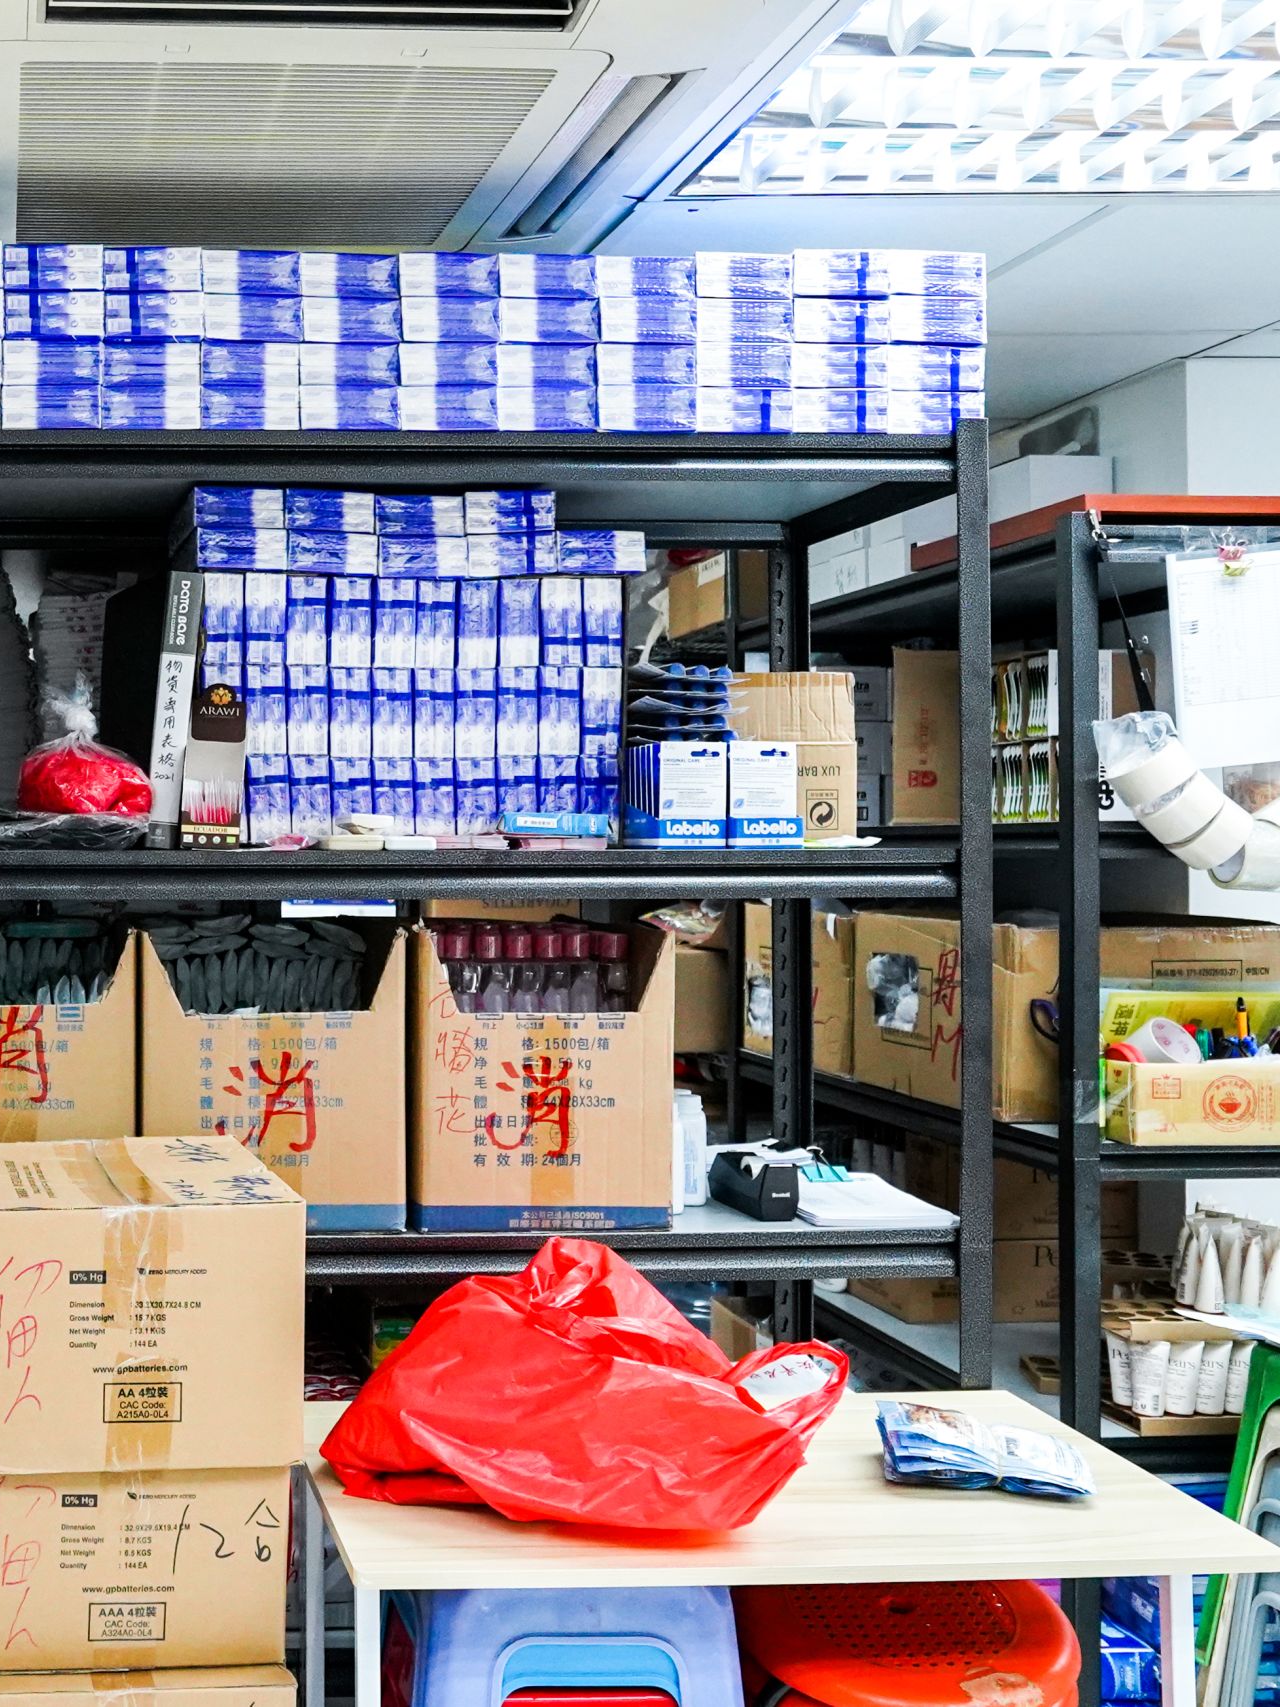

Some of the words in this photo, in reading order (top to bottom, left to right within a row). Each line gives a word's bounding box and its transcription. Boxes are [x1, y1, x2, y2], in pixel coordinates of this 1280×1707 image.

[199, 706, 240, 717] ARAWI
[154, 771, 175, 782] 2021
[797, 766, 818, 777] BAR
[822, 765, 841, 777] LUX
[193, 826, 228, 834] ECUADOR
[666, 820, 720, 836] Labello
[743, 819, 797, 835] Labello
[545, 1037, 610, 1051] 1500包/箱
[72, 1272, 88, 1281] 0%
[89, 1272, 104, 1283] Hg
[69, 1301, 105, 1309] Dimension
[189, 1300, 202, 1308] CM
[69, 1314, 90, 1322] Gross
[91, 1314, 115, 1323] Weight
[150, 1314, 167, 1322] KGS
[82, 1327, 106, 1336] Weight
[69, 1341, 97, 1350] Quantity
[134, 1340, 146, 1348] 144
[147, 1339, 158, 1348] EA
[92, 1363, 188, 1374] www.gpbatteries.com
[1168, 1358, 1196, 1370] ears
[118, 1388, 134, 1398] AA
[120, 1401, 139, 1410] CAC
[142, 1401, 166, 1410] Code:
[64, 1496, 80, 1505] 0%
[81, 1496, 95, 1507] Hg
[136, 1549, 152, 1557] KGS
[59, 1562, 87, 1570] Quantity
[81, 1584, 175, 1594] www.gpbatteries.com
[98, 1607, 125, 1618] AAA
[104, 1620, 122, 1629] CAC
[125, 1620, 151, 1629] Code:
